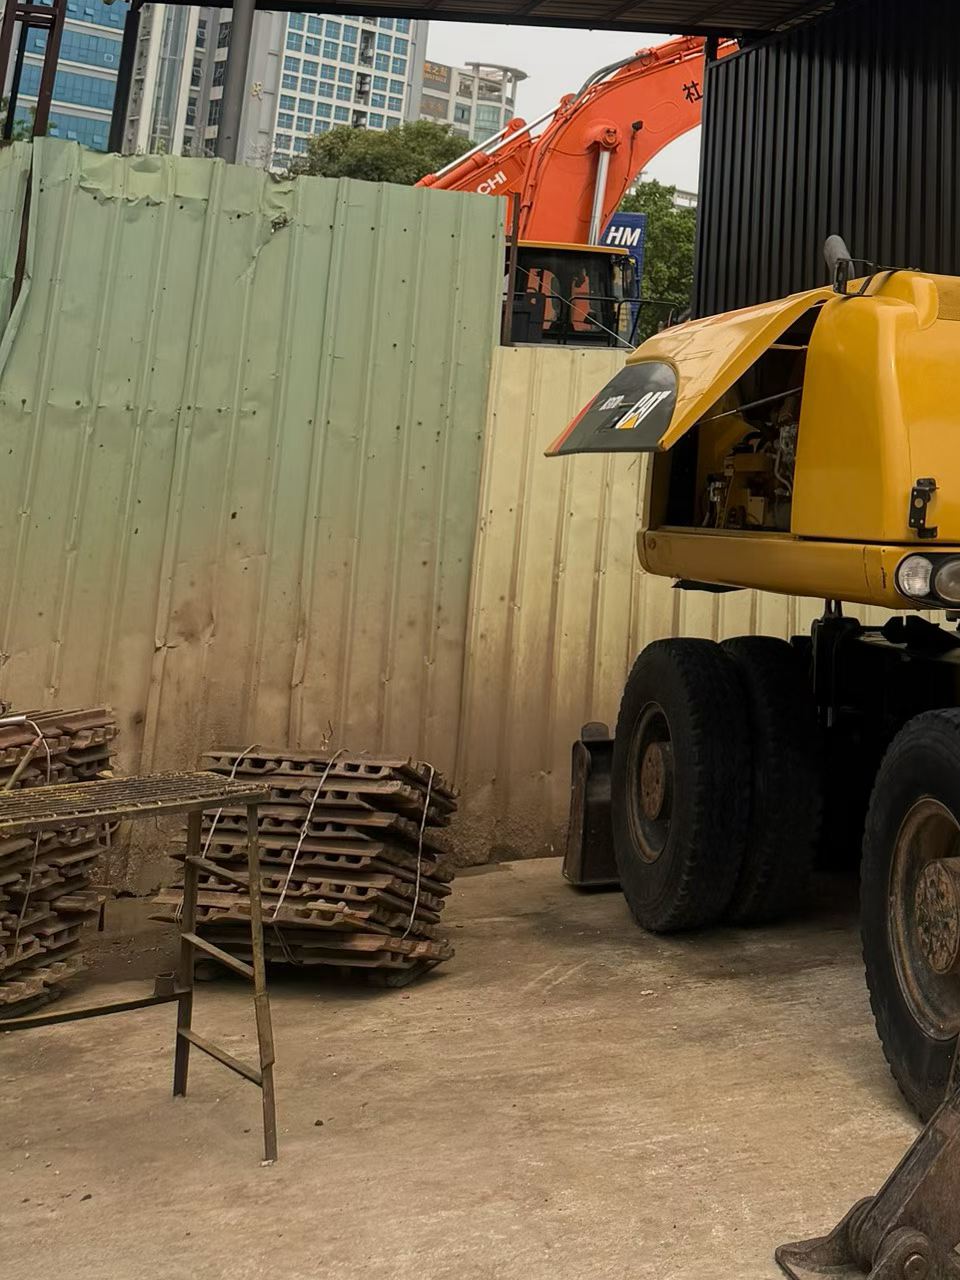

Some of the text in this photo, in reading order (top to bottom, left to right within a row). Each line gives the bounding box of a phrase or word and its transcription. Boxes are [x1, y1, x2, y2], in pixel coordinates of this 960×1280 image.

[477, 170, 507, 195] CHI
[606, 225, 642, 247] HM
[615, 390, 673, 429] CAT
